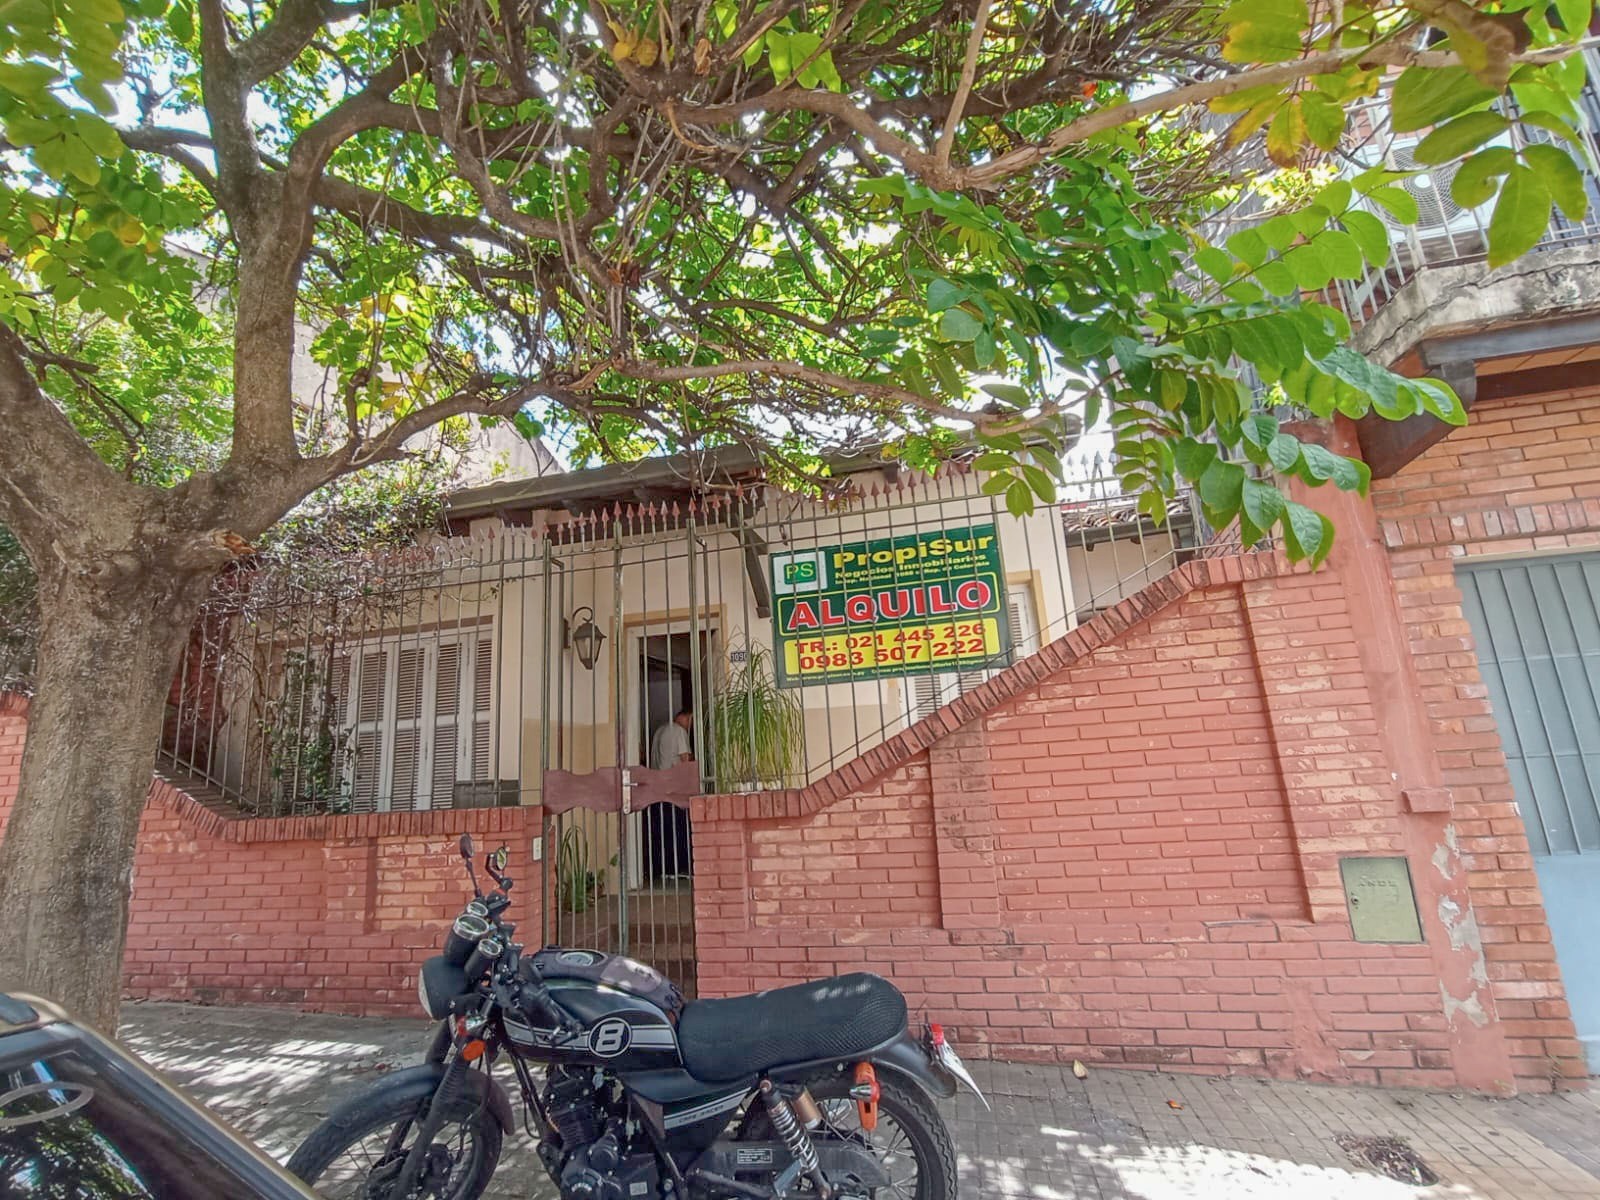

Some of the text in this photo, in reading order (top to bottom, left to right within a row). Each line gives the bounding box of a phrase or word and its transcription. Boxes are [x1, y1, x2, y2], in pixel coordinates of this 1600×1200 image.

[833, 535, 993, 569] PropiSur
[835, 554, 986, 579] Negocios Inmobiiarios
[786, 563, 814, 580] PS
[787, 580, 990, 630] ALQUILO
[795, 623, 986, 655] TR.: 021 445 226
[799, 652, 864, 670] 0983
[874, 645, 922, 663] 507
[932, 638, 984, 657] 222
[595, 1023, 625, 1052] 8
